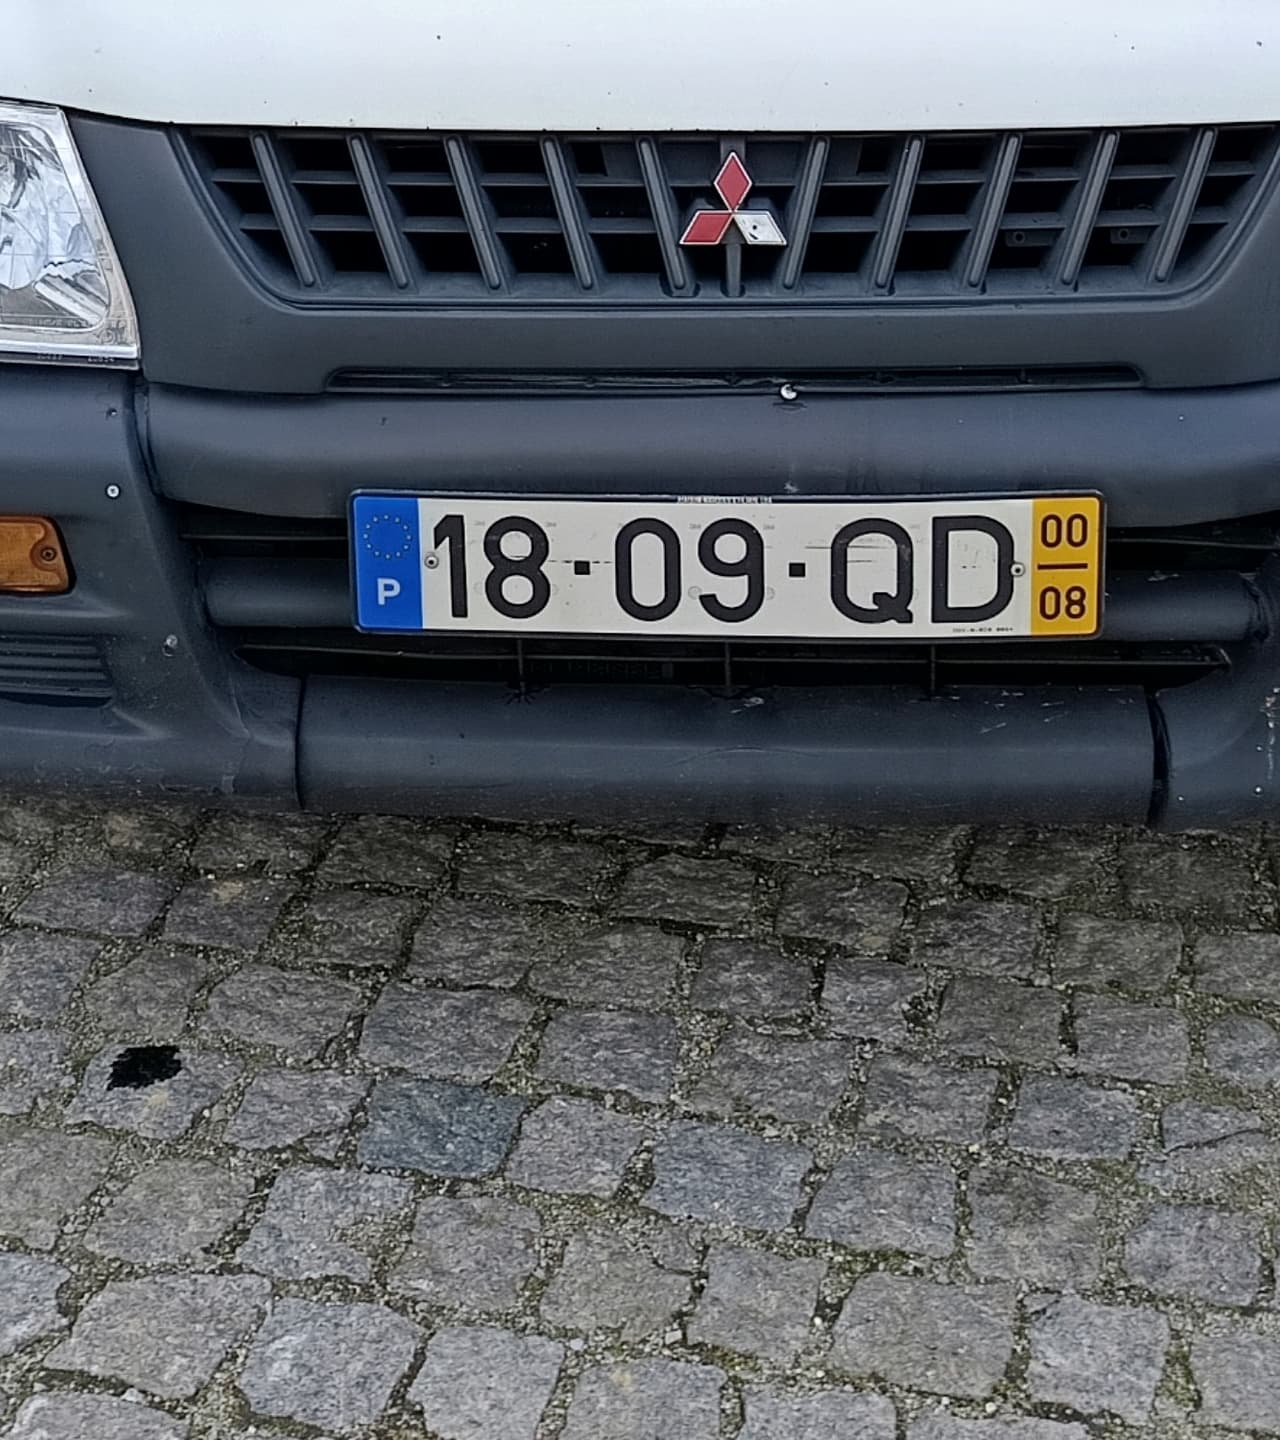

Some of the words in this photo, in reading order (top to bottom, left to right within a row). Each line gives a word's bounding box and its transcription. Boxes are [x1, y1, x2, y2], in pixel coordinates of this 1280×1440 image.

[1040, 513, 1088, 548] 00
[376, 577, 402, 606] P
[1039, 585, 1087, 620] 08
